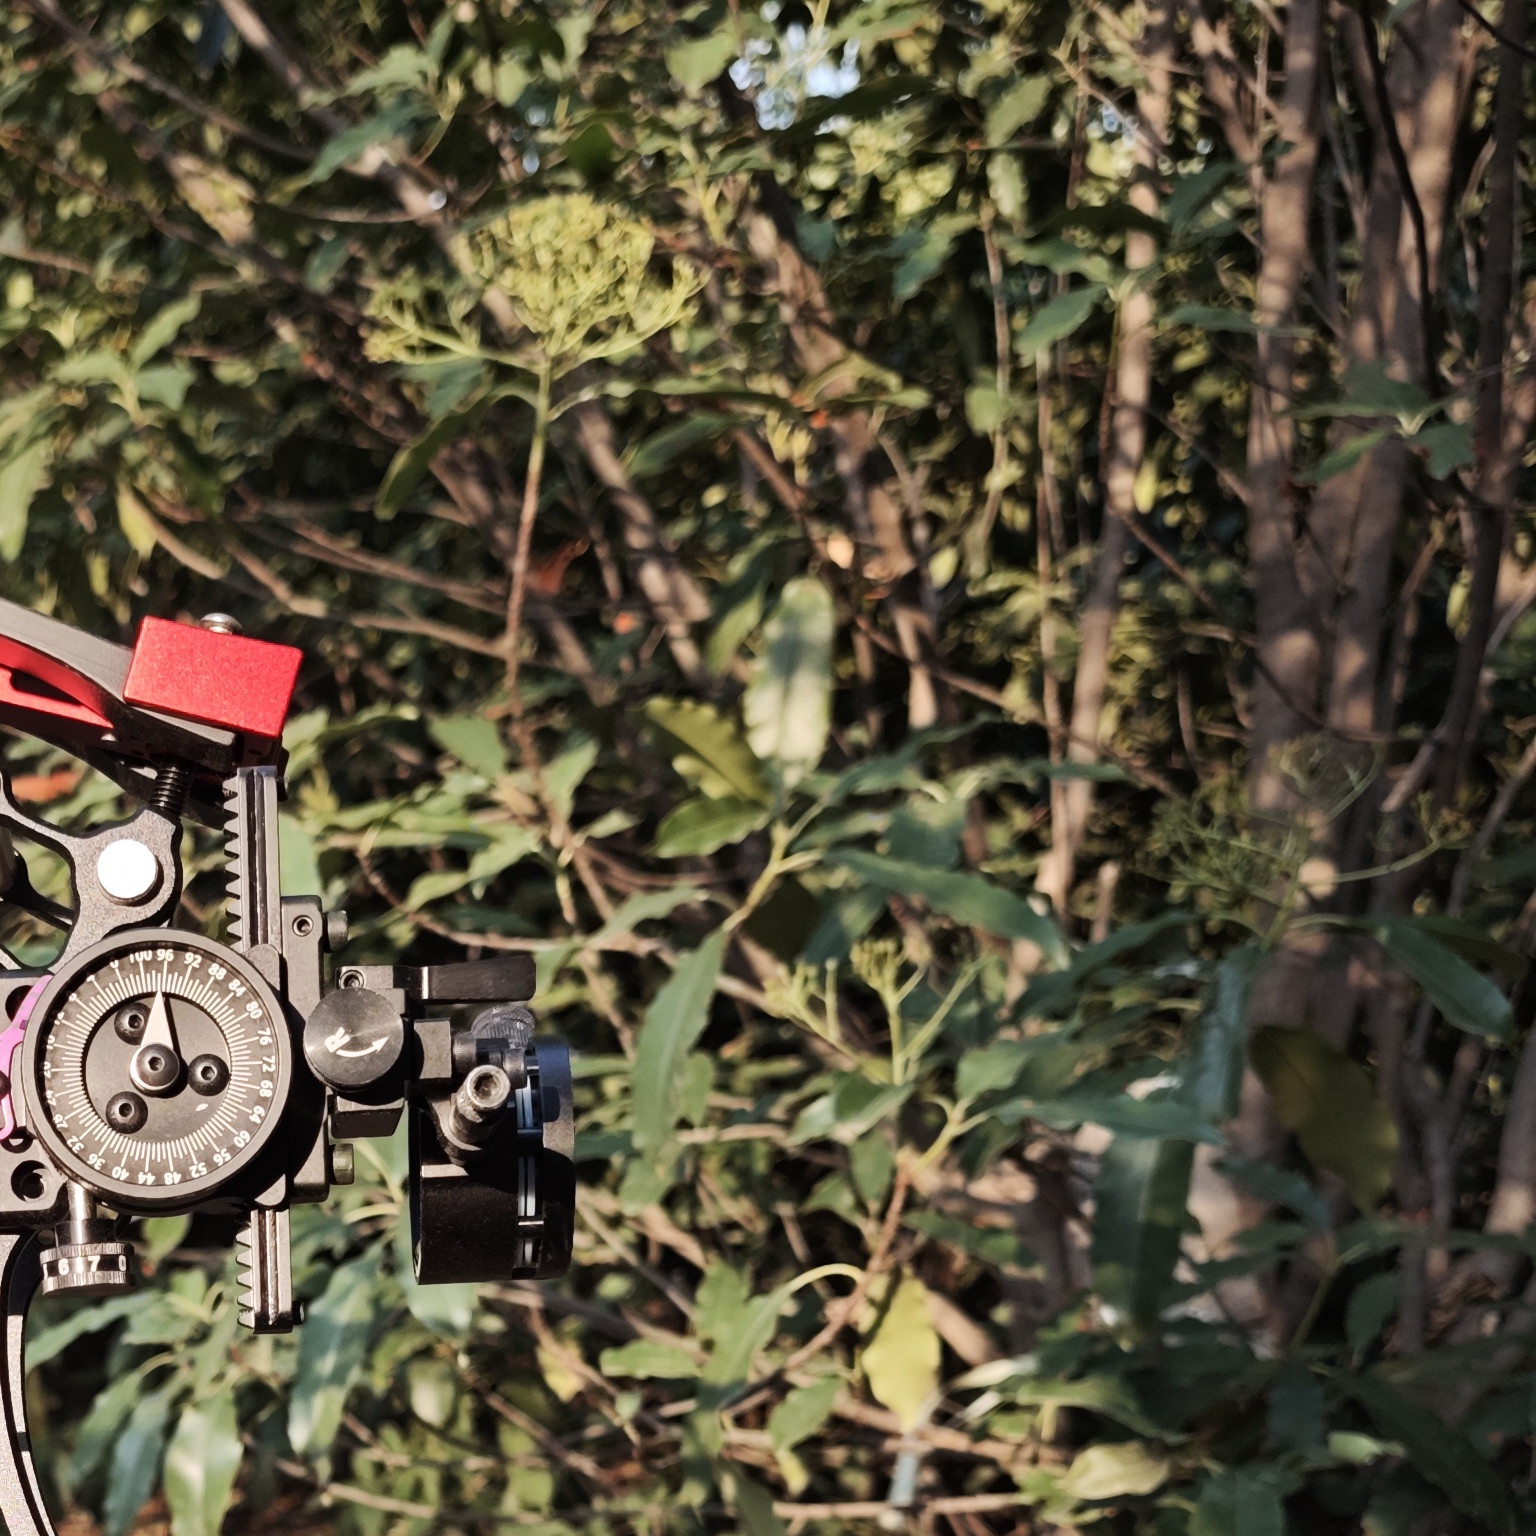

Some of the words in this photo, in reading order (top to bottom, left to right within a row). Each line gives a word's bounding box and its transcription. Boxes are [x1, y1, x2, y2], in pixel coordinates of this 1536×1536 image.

[156, 948, 174, 962] 96
[183, 952, 202, 969] 92
[208, 963, 227, 980] 88
[228, 978, 247, 998] 84
[245, 1001, 263, 1019] 80
[257, 1027, 273, 1046] 76
[324, 1026, 351, 1053] R
[262, 1055, 276, 1073] 72
[259, 1079, 274, 1098] 68
[53, 1113, 69, 1129] 28
[249, 1105, 266, 1124] 64
[66, 1135, 85, 1154] 32
[233, 1130, 251, 1148] 60
[86, 1153, 106, 1171] 36
[212, 1147, 232, 1167] 56
[111, 1166, 130, 1181] 40
[137, 1171, 156, 1186] 44
[164, 1171, 182, 1186] 48
[189, 1162, 208, 1178] 52
[58, 1258, 70, 1276] 6
[87, 1255, 101, 1272] 7
[118, 1255, 127, 1272] 0
